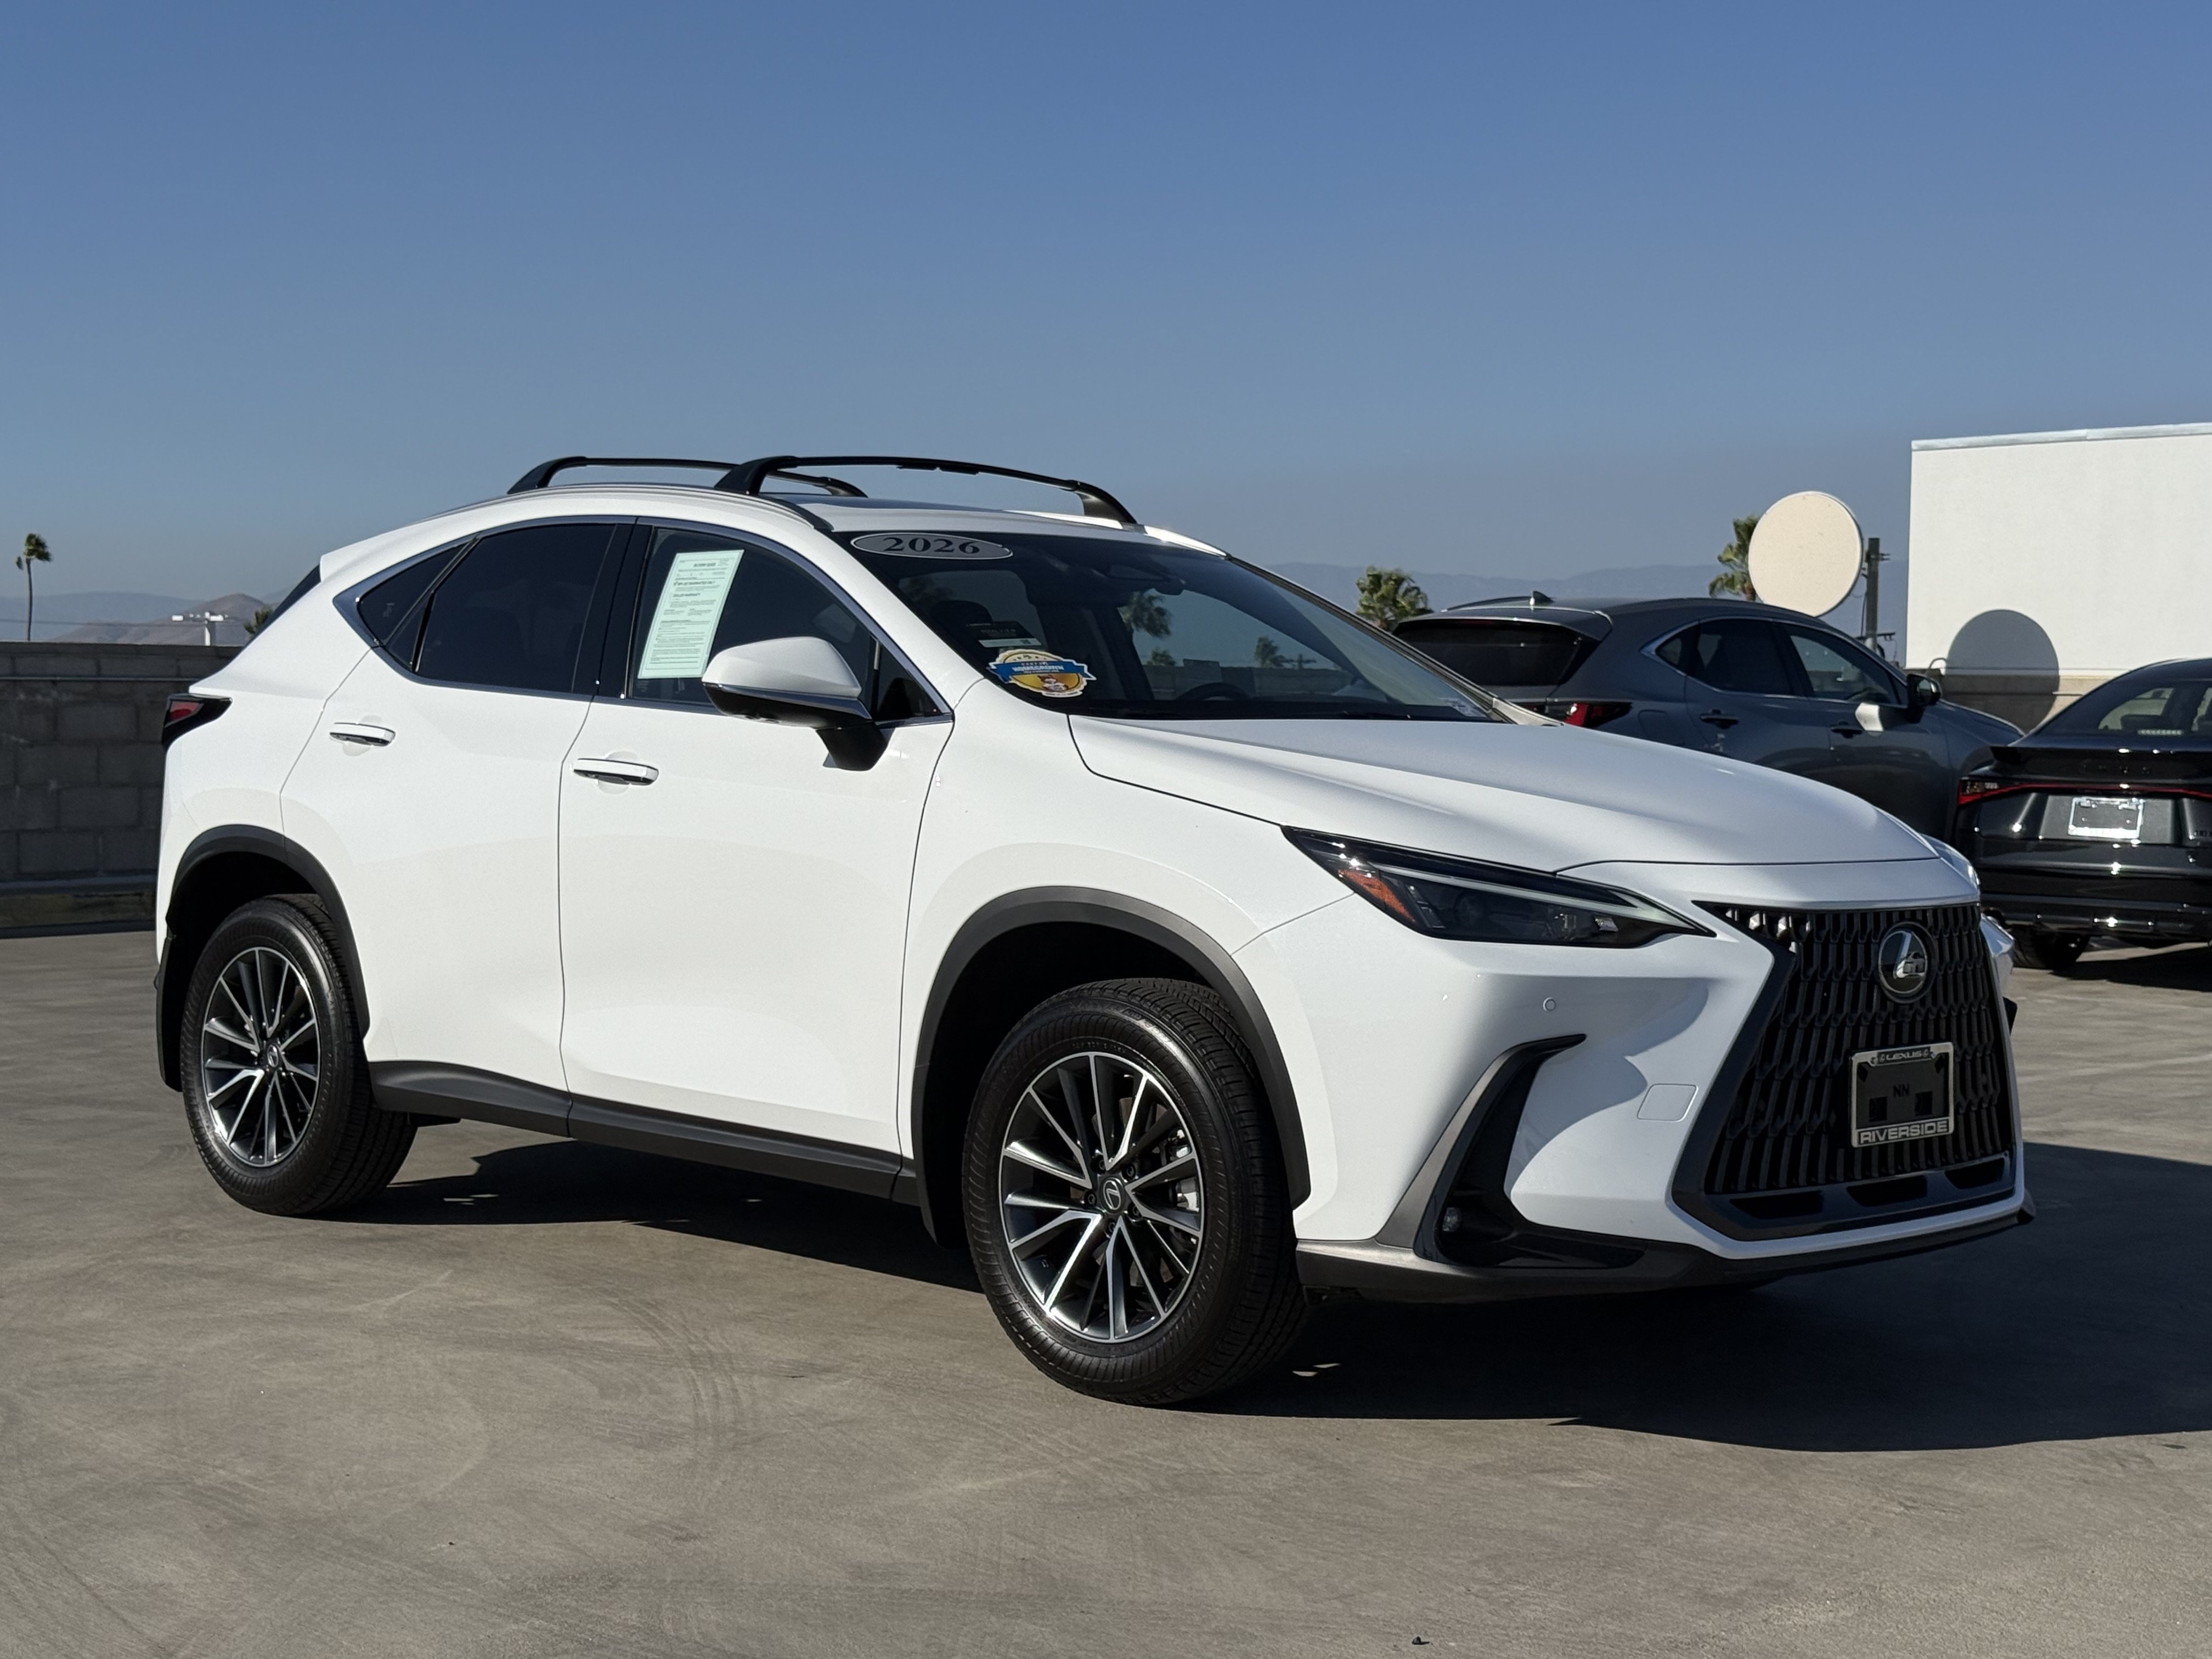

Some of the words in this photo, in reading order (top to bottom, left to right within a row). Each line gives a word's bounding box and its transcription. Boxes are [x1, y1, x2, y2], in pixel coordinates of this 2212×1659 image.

[883, 537, 980, 554] 2026
[1886, 1051, 1922, 1060] LEXUS
[1893, 1083, 1910, 1097] NN
[1860, 1121, 1948, 1144] RIVERSIDE
